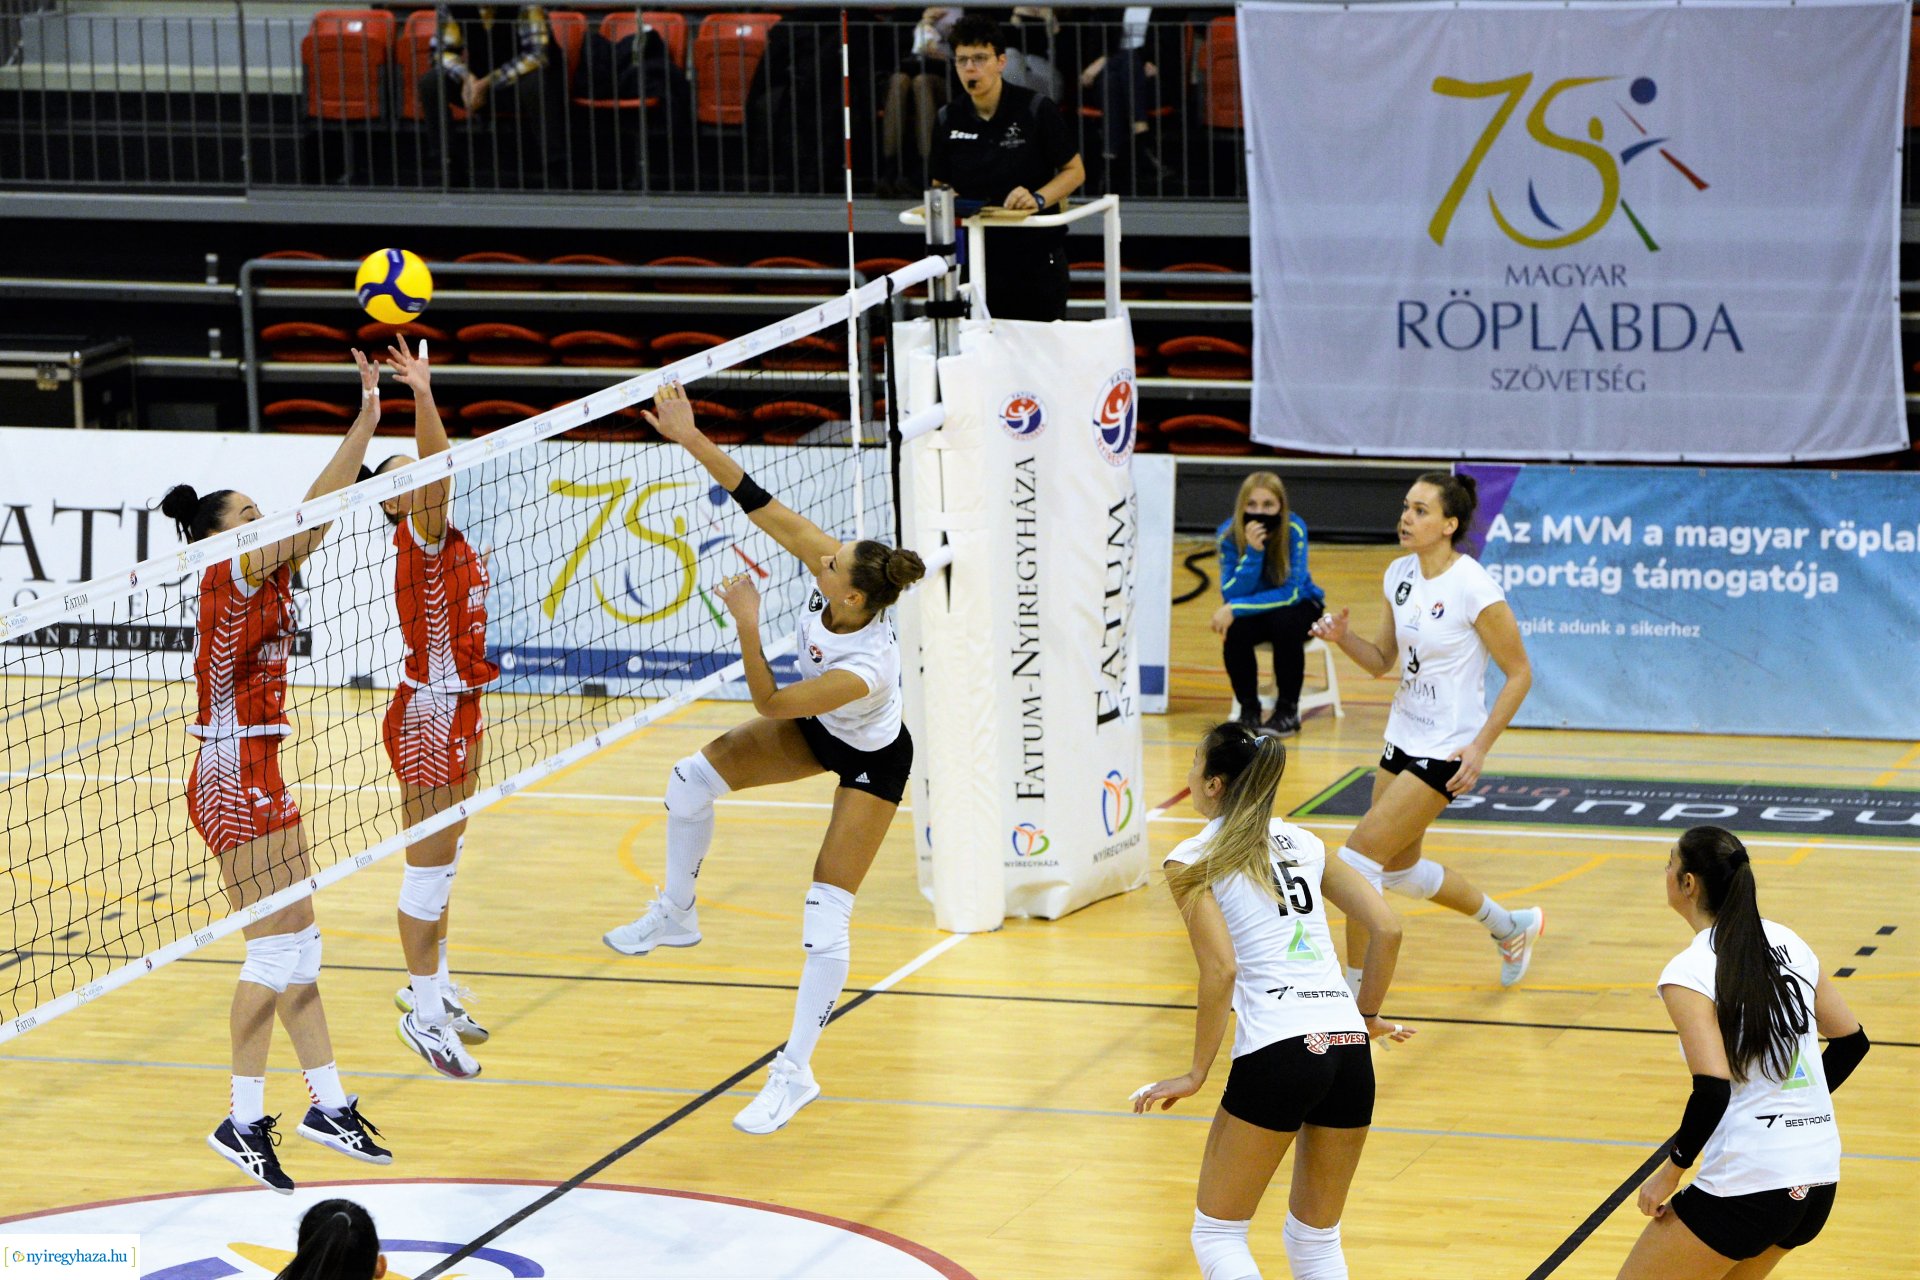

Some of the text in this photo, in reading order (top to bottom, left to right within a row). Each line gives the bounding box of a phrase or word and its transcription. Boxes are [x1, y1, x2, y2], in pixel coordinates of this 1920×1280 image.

[1505, 263, 1628, 288] MAGYAR
[1397, 289, 1745, 353] RÖPLABDA
[1491, 364, 1646, 393] SZÖVETSÉG
[236, 531, 259, 549] FATUM
[1485, 513, 1920, 558] Az MVM a magyar röpla
[1486, 556, 1839, 599] sportág támogatója
[64, 593, 88, 612] FATUM
[1095, 496, 1128, 735] FATUM
[1517, 617, 1700, 637] rgiát adunk a sikerhez
[1269, 860, 1314, 917] 15
[194, 931, 214, 947] FATUM
[15, 1016, 37, 1033] FATUM
[1784, 1113, 1831, 1128] BESTRONG
